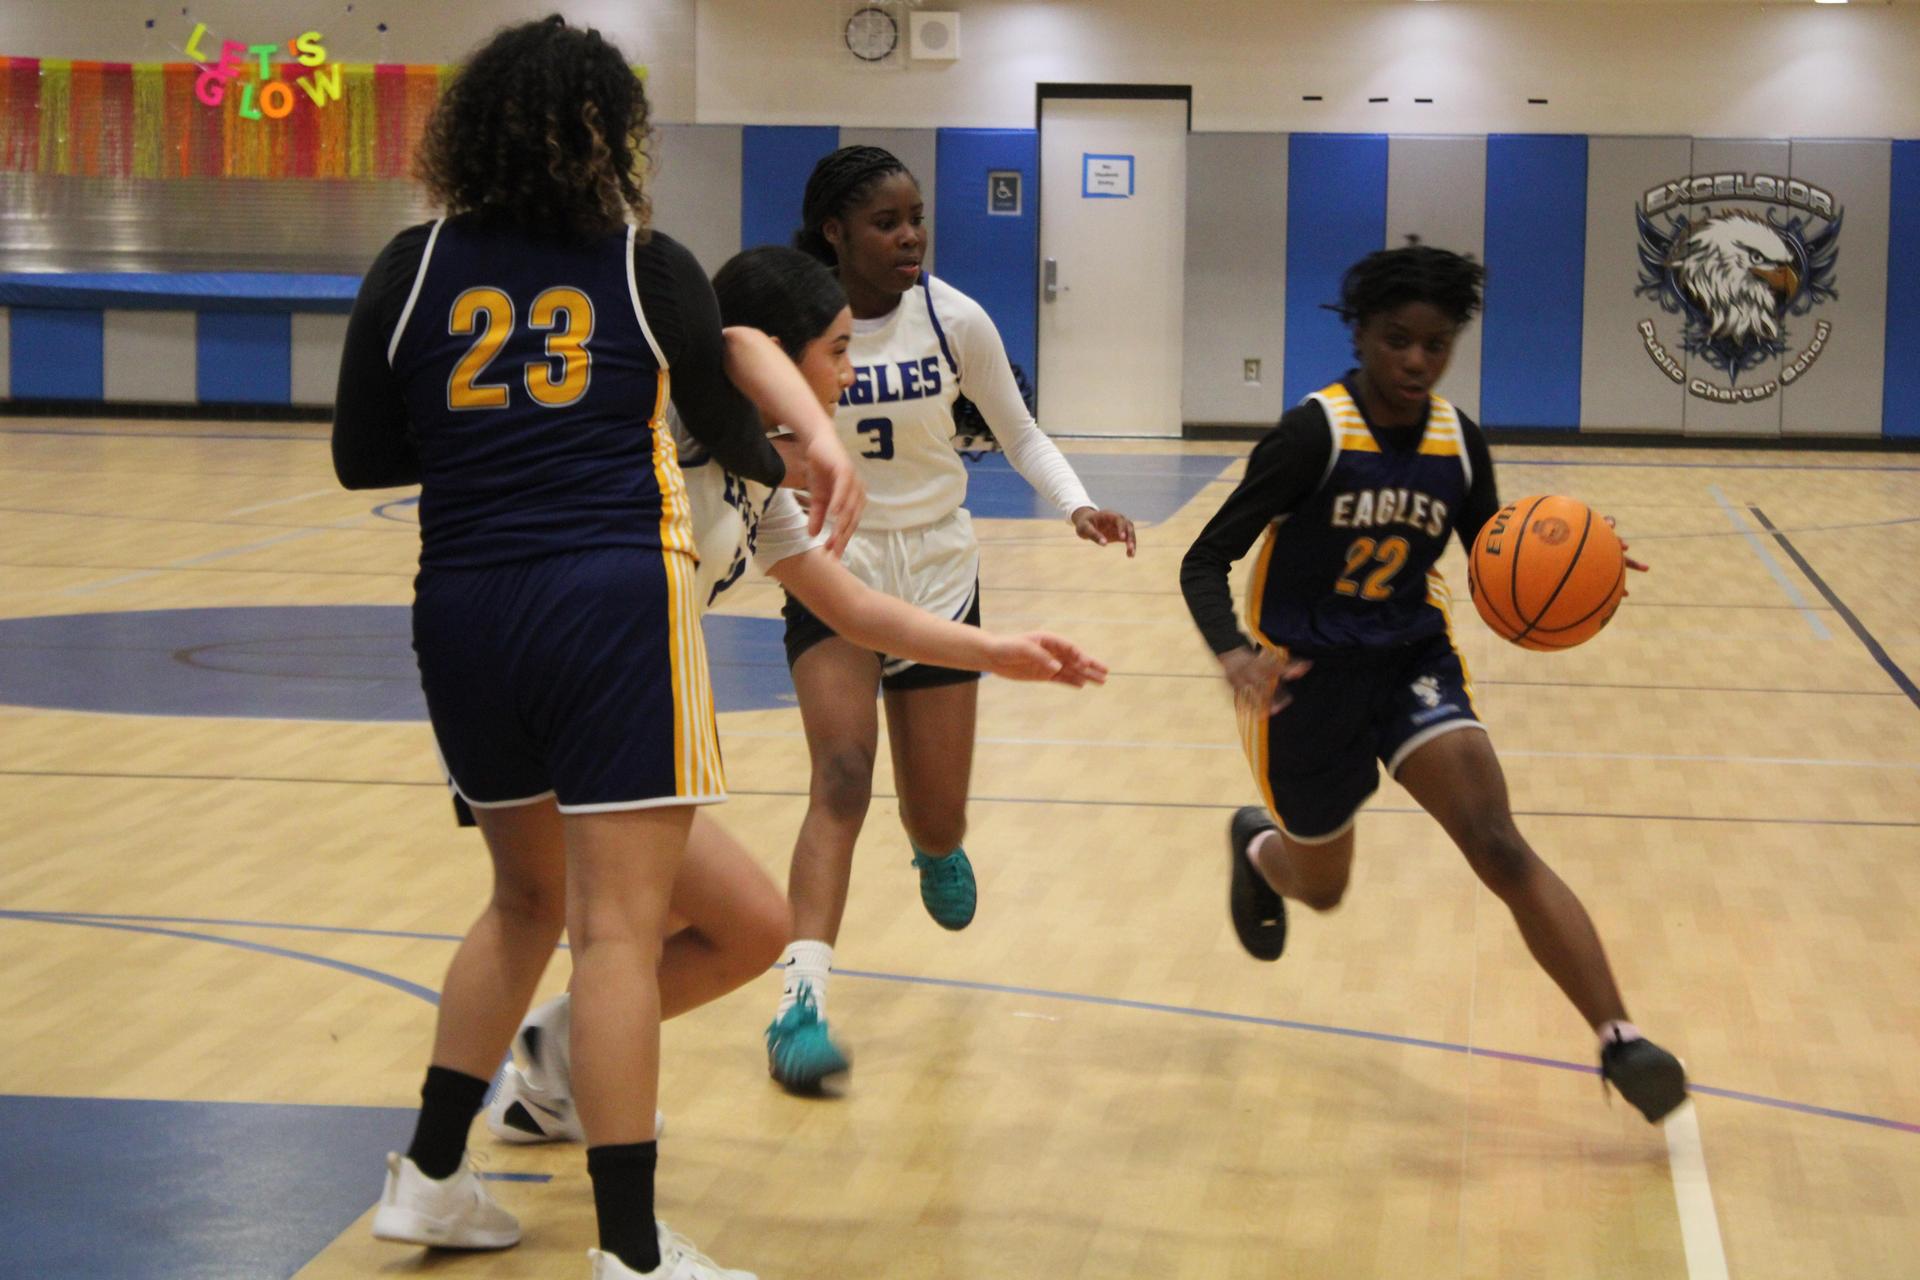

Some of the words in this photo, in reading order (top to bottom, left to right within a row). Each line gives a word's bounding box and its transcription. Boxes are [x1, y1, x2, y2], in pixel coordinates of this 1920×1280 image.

[184, 22, 327, 81] LET'S
[195, 63, 342, 120] GLOW
[1644, 173, 1835, 219] EXCELSIOR
[447, 286, 595, 411] 23
[1638, 318, 1686, 384] Public
[1689, 379, 1778, 403] Charter
[1780, 319, 1832, 386] School
[838, 356, 942, 406] GLES
[857, 417, 894, 460] 3
[1331, 488, 1447, 536] EAGLES
[1335, 536, 1409, 600] 22
